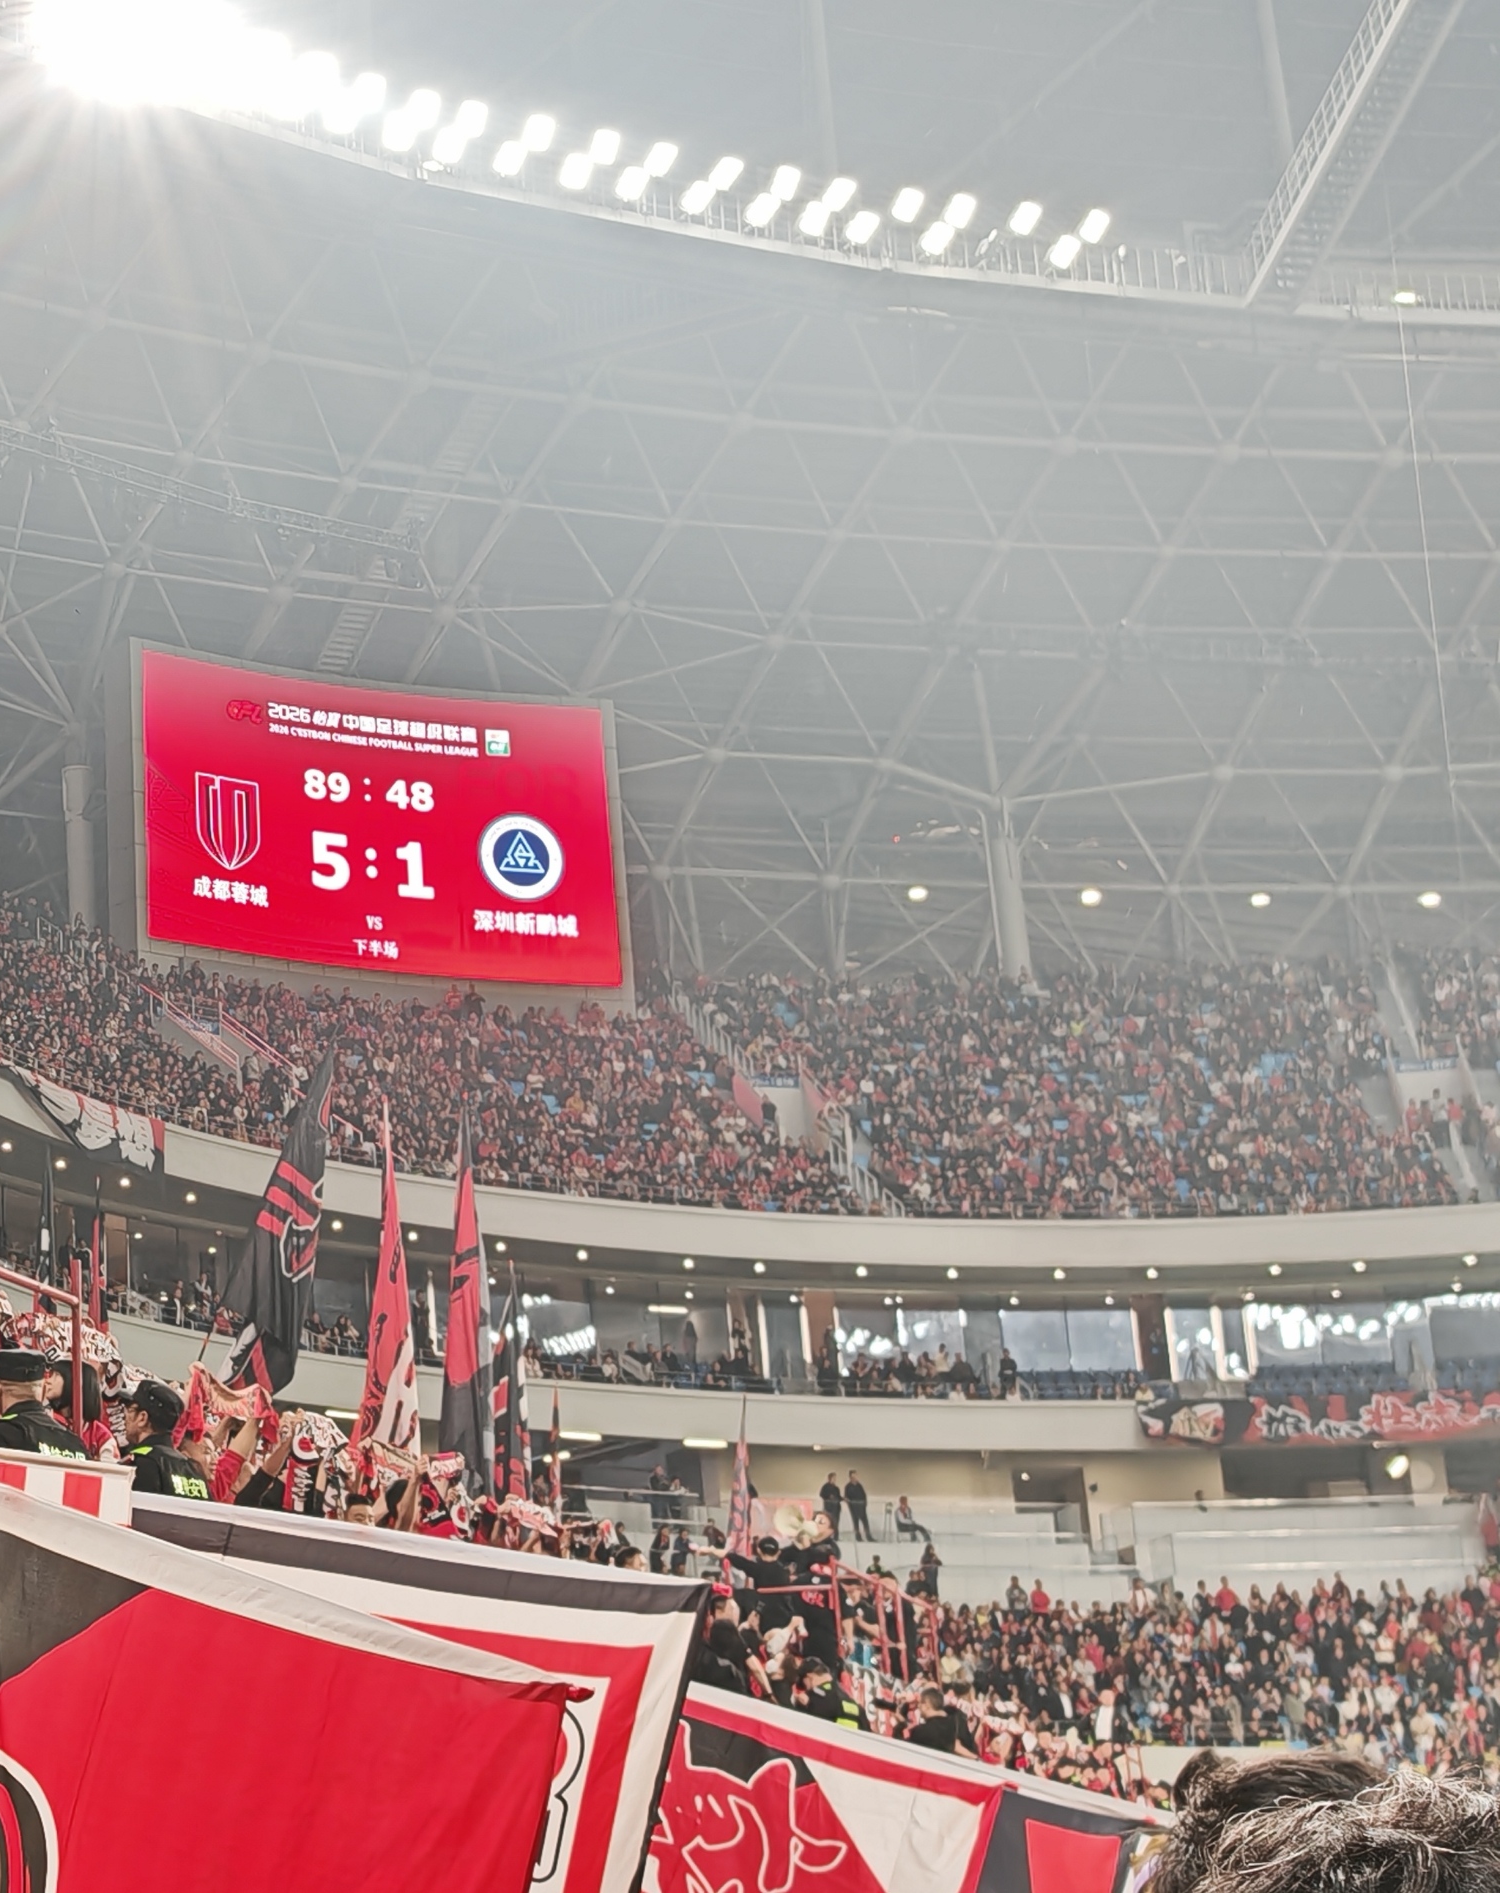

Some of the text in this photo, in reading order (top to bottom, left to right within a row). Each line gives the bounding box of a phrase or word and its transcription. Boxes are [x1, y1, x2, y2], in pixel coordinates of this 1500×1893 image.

[267, 701, 311, 724] 2026
[342, 712, 479, 744] 中国足球超级联赛
[268, 722, 290, 735] 2026
[332, 732, 368, 747] CHINESE
[369, 737, 414, 752] FOOTBALL
[414, 743, 444, 755] SUPER
[444, 746, 480, 758] LEAGUE
[192, 876, 269, 909] 成都蓉城
[365, 914, 384, 931] VS
[472, 908, 580, 938] 深圳新鹏城
[352, 938, 399, 960] 下半场
